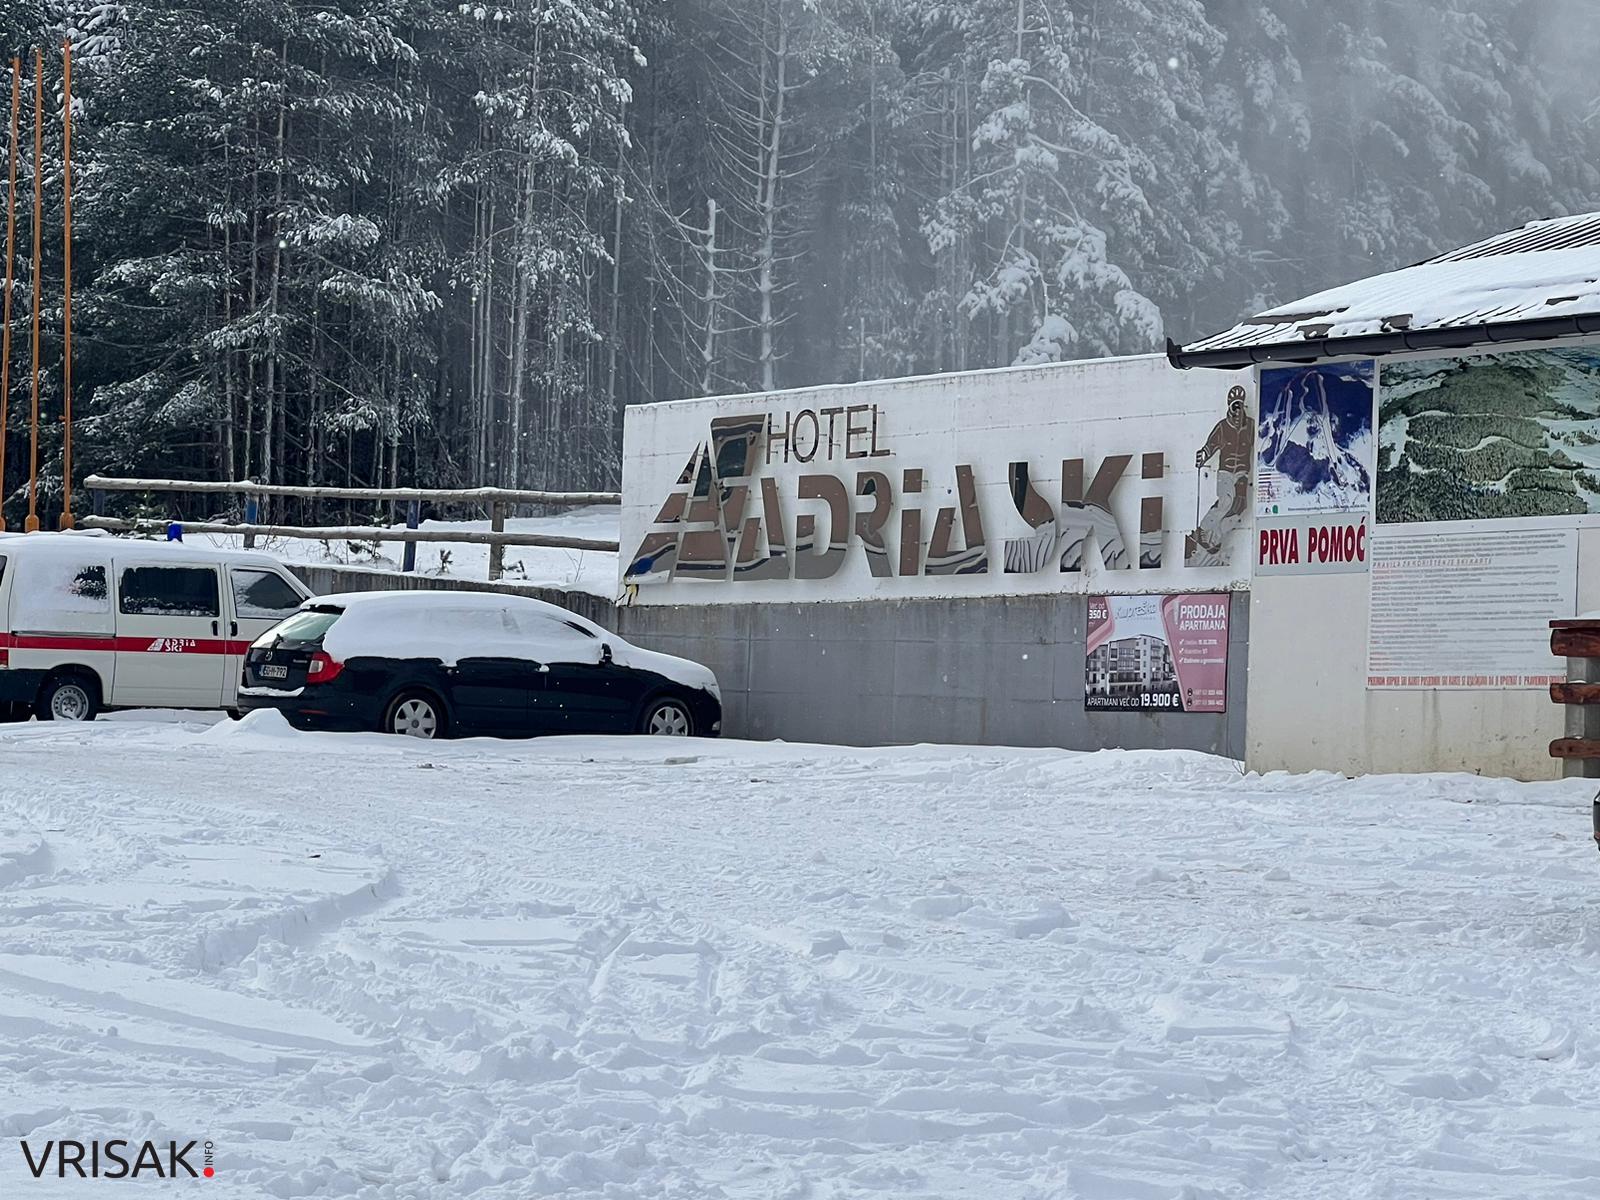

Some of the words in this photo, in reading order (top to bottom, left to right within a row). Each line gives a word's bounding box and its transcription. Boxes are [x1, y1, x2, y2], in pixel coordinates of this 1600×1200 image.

[766, 404, 891, 464] HOTEL
[1259, 528, 1299, 565] PRVA
[1307, 516, 1366, 563] POMOĆ
[1088, 609, 1101, 619] 350
[1102, 609, 1107, 619] €
[1180, 605, 1226, 619] PRODAJA
[1179, 620, 1226, 631] APARTMANA
[1086, 697, 1118, 706] APARTMANI
[1131, 697, 1140, 706] OD
[1140, 693, 1171, 707] 19.900
[1172, 693, 1179, 706] €
